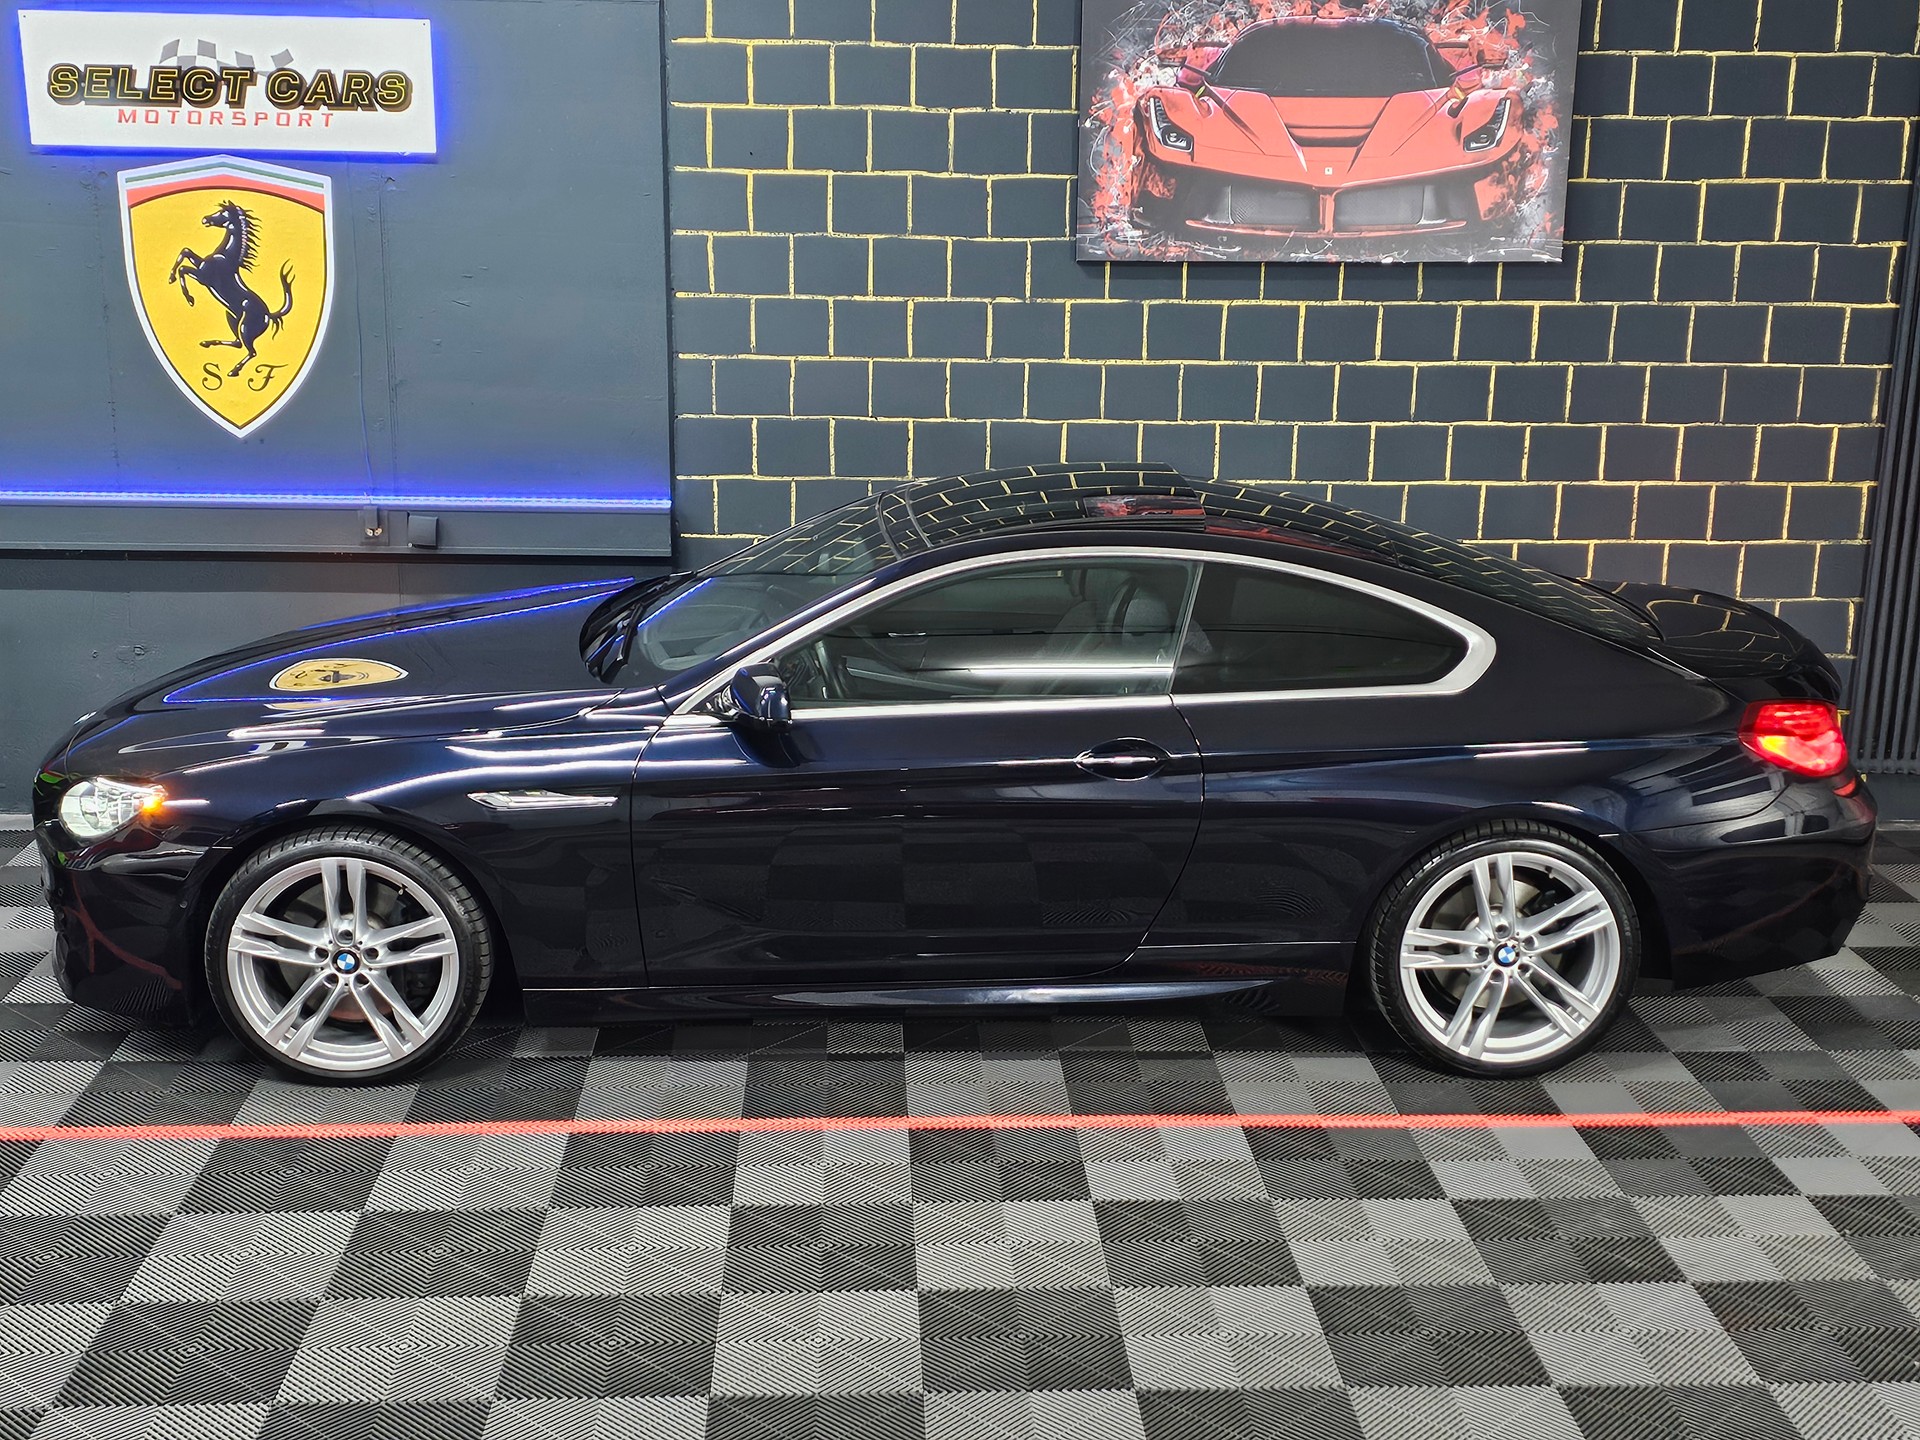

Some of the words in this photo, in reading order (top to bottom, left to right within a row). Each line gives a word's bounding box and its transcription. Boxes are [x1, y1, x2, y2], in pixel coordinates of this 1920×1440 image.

[48, 63, 257, 108] SELECT
[265, 67, 413, 112] CARS
[118, 108, 334, 127] MOTORSPORT
[201, 362, 223, 391] S
[247, 363, 289, 391] F
